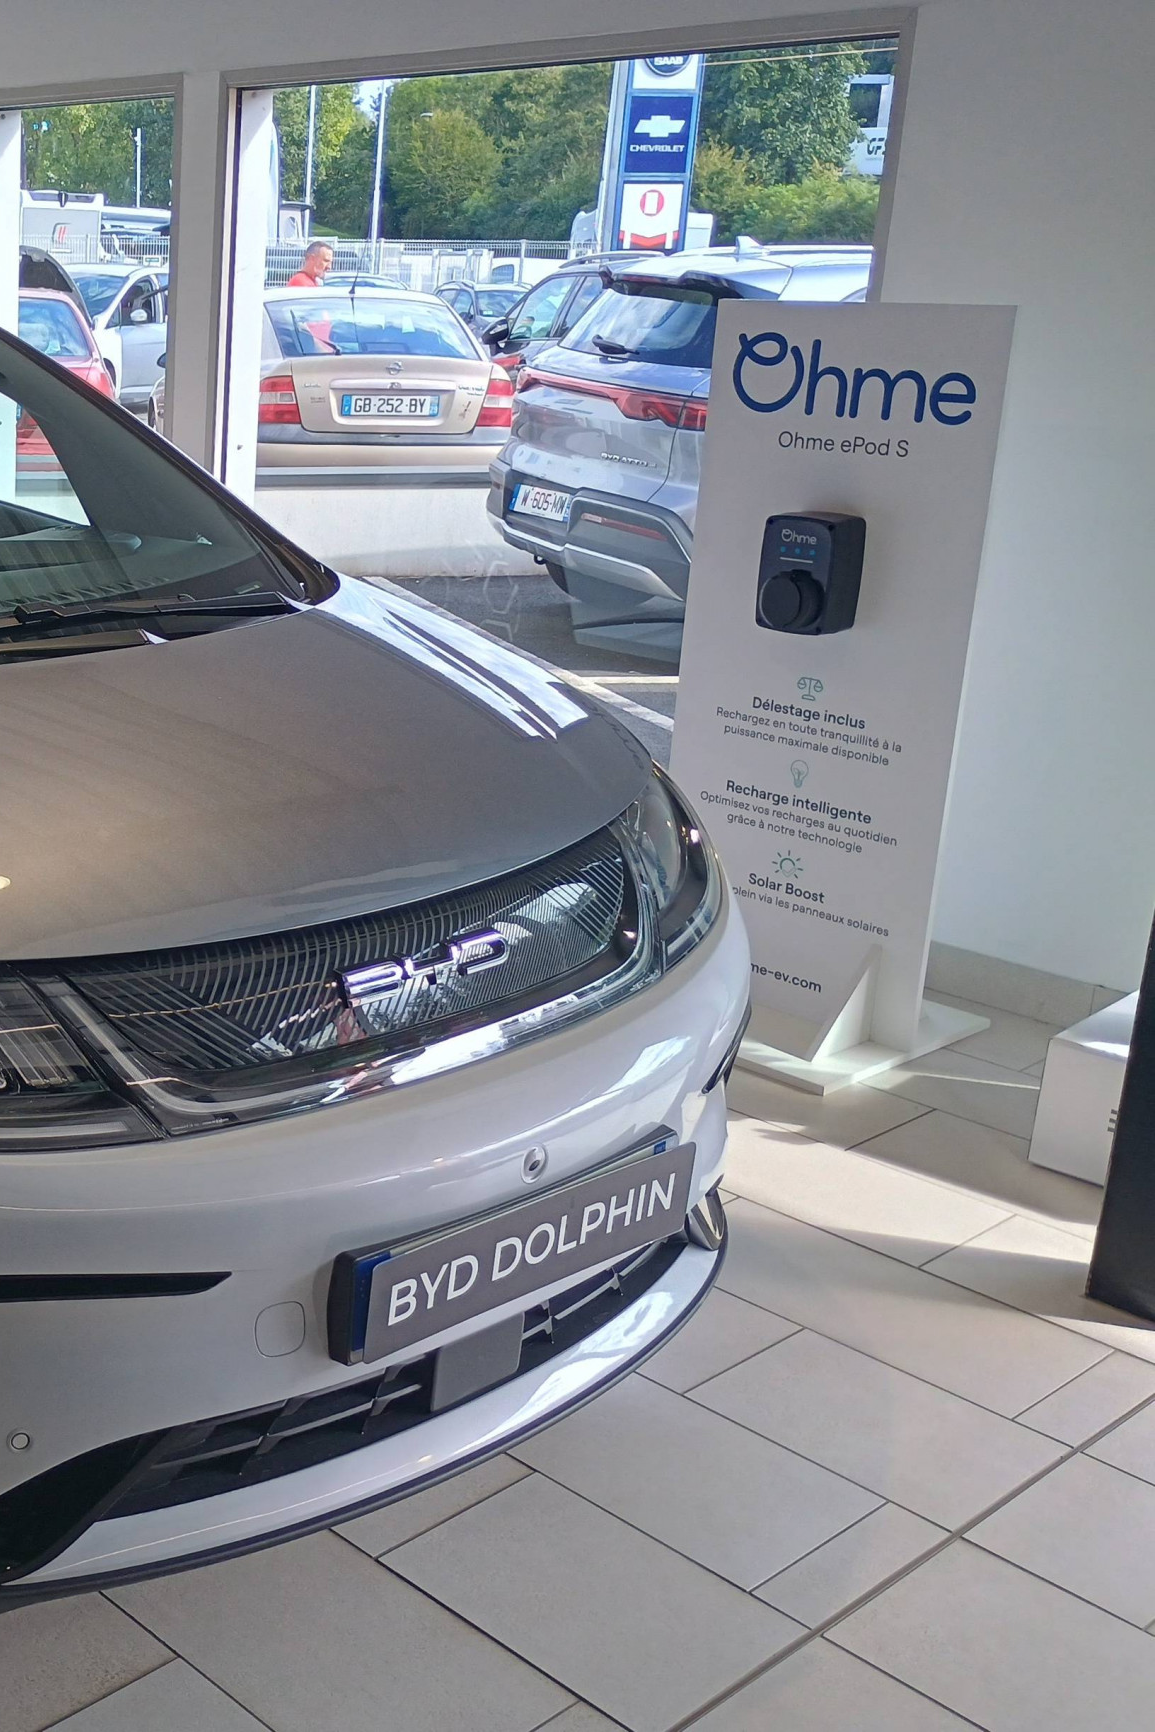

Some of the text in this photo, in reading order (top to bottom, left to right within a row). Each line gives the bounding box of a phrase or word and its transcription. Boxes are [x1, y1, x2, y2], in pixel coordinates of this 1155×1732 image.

[654, 56, 684, 66] SAAB
[629, 144, 686, 152] CHEVROLET
[732, 331, 977, 426] Ohme
[778, 430, 909, 458] Ohme ePod S
[781, 528, 817, 545] Ohme
[716, 706, 771, 727] Rechargez
[772, 719, 787, 730] en
[788, 721, 818, 736] toute
[882, 739, 890, 751] à
[891, 742, 903, 753] la
[752, 696, 866, 730] Délestage inclus
[723, 724, 890, 767] puissance maximale disponible
[700, 790, 898, 847] Optimisez vos recharges au quotidien
[726, 779, 872, 825] Recharge intelligente
[726, 812, 864, 854] grâce à notre technologie
[748, 872, 826, 904] Solar Boost
[758, 892, 773, 905] via
[775, 896, 790, 910] les
[792, 902, 845, 925] panneaux
[846, 917, 890, 938] solaires
[338, 928, 510, 1004] BYD
[387, 1172, 677, 1327] BYD DOLPHIN
